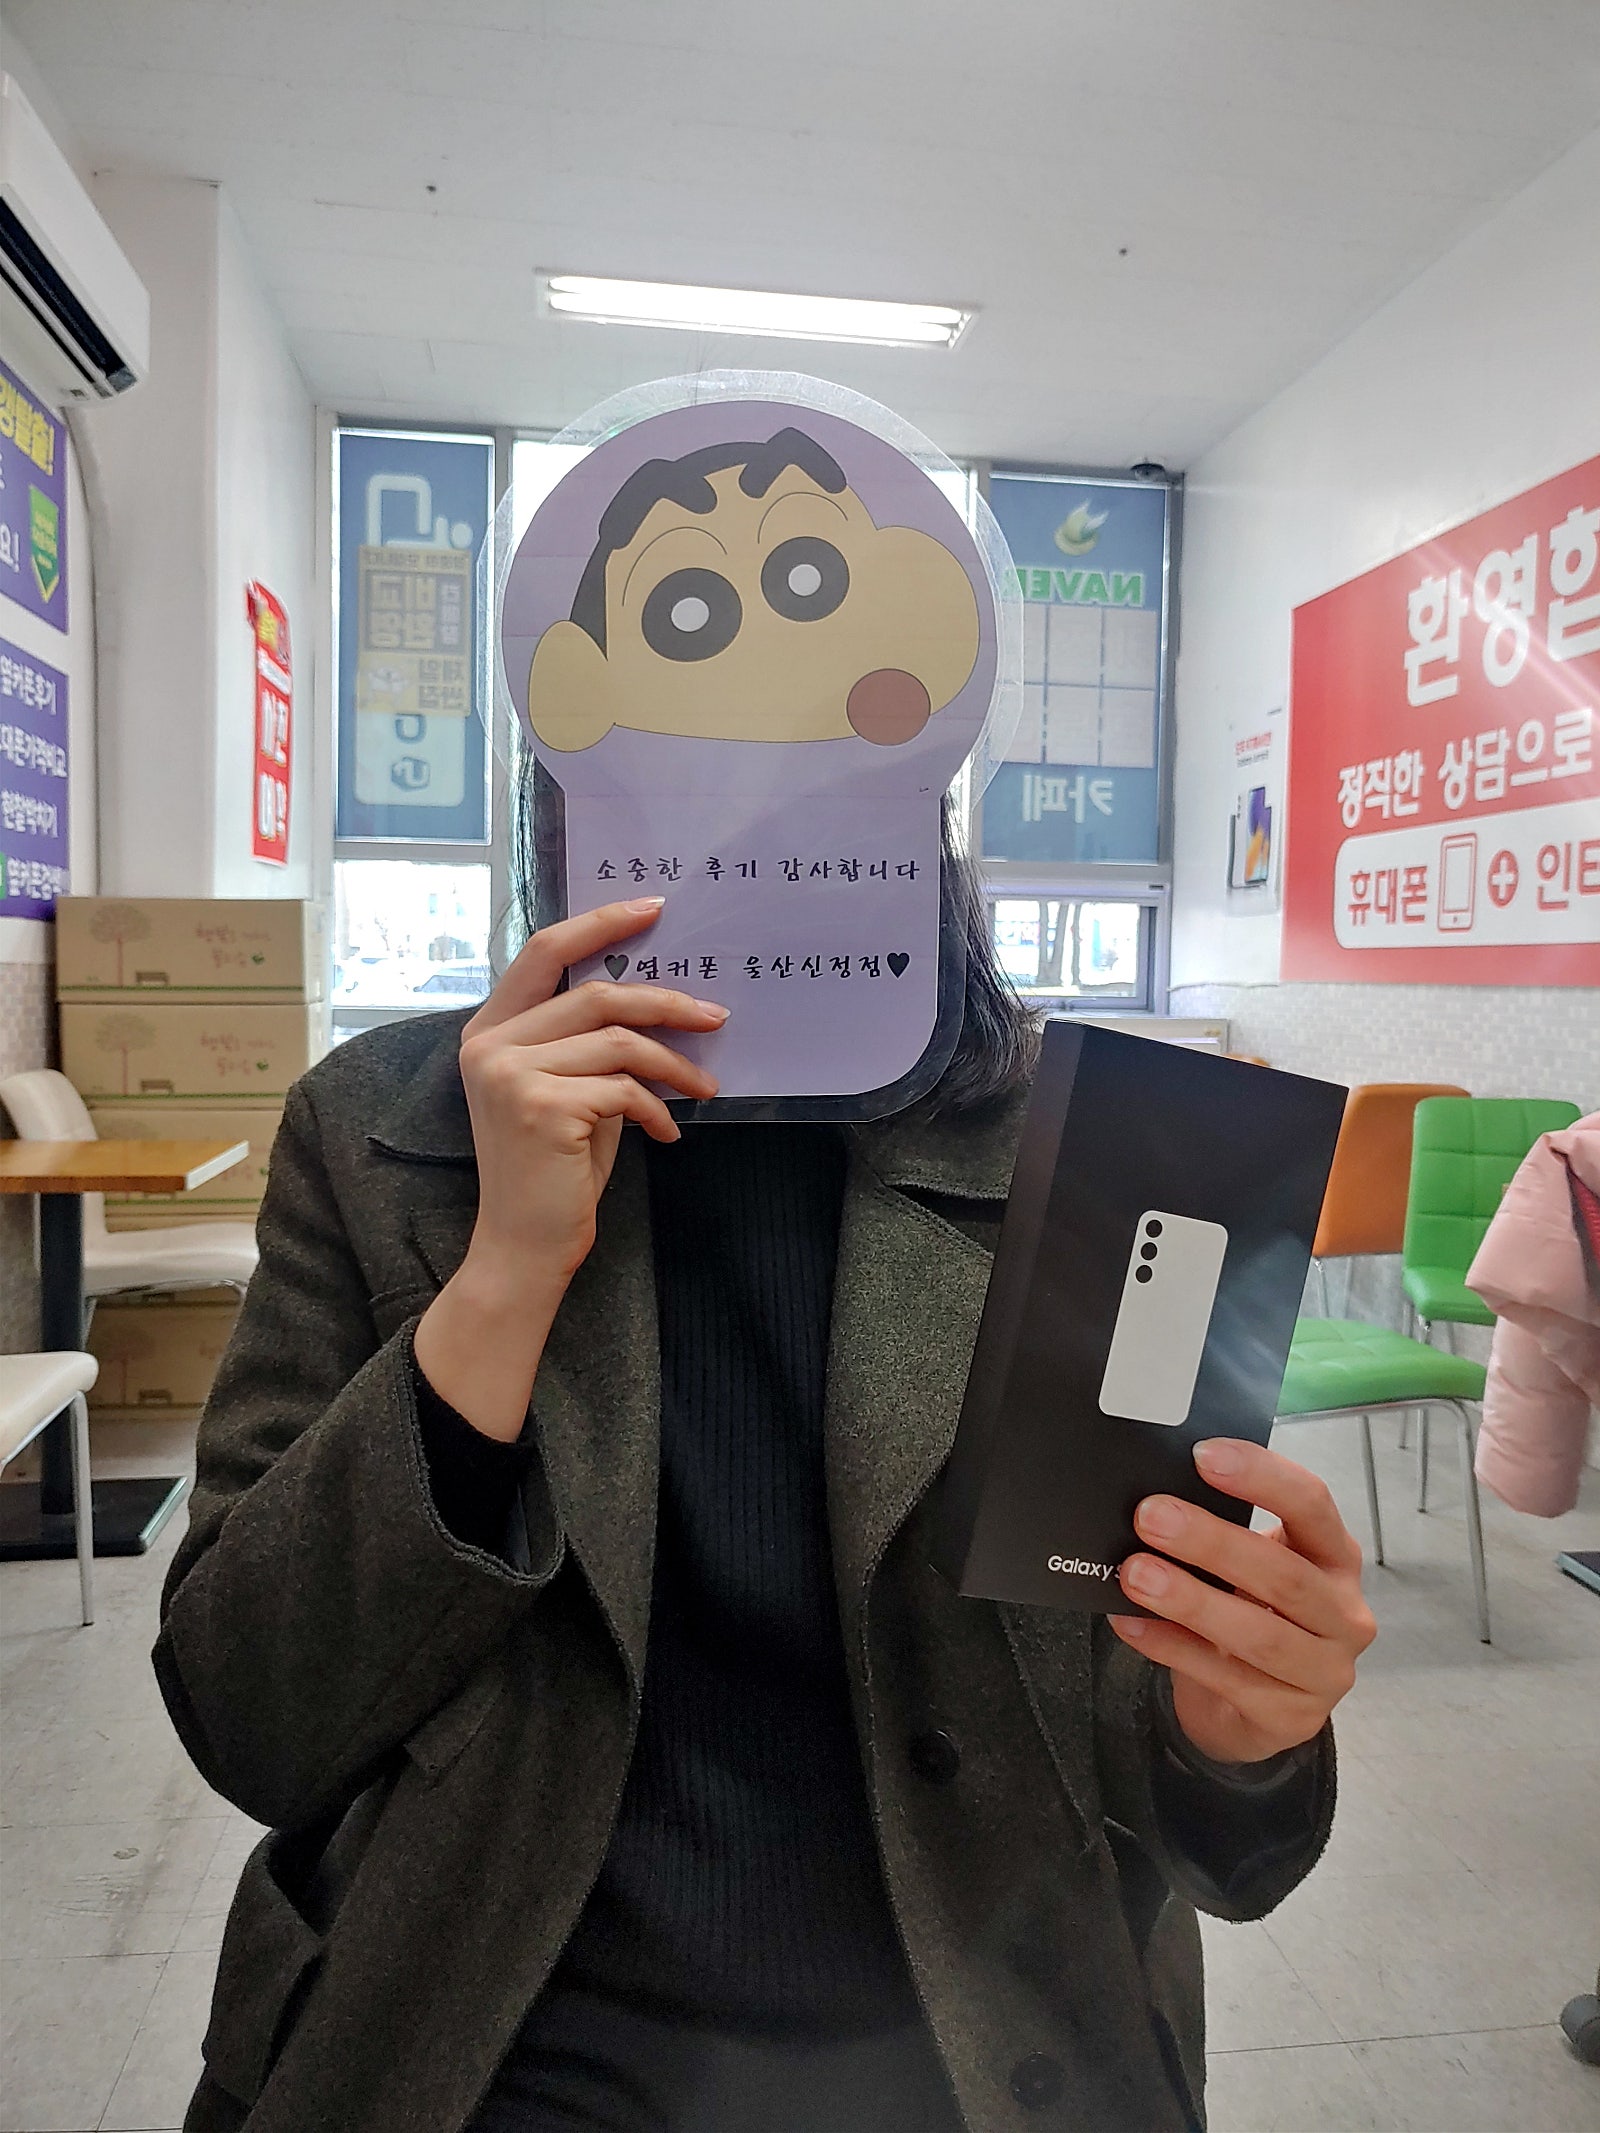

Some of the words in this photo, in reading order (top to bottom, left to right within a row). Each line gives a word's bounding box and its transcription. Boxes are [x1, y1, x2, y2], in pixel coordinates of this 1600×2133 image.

[1337, 749, 1425, 829] 정직한
[1437, 708, 1593, 811] 상담으로
[596, 856, 683, 882] 소중한
[705, 856, 758, 882] 후기
[777, 857, 921, 882] 감사합니다
[1347, 865, 1429, 927] 휴대폰
[636, 954, 719, 981] 옆커폰
[742, 954, 882, 980] 울산신정점
[1047, 1555, 1114, 1582] Galaxy
